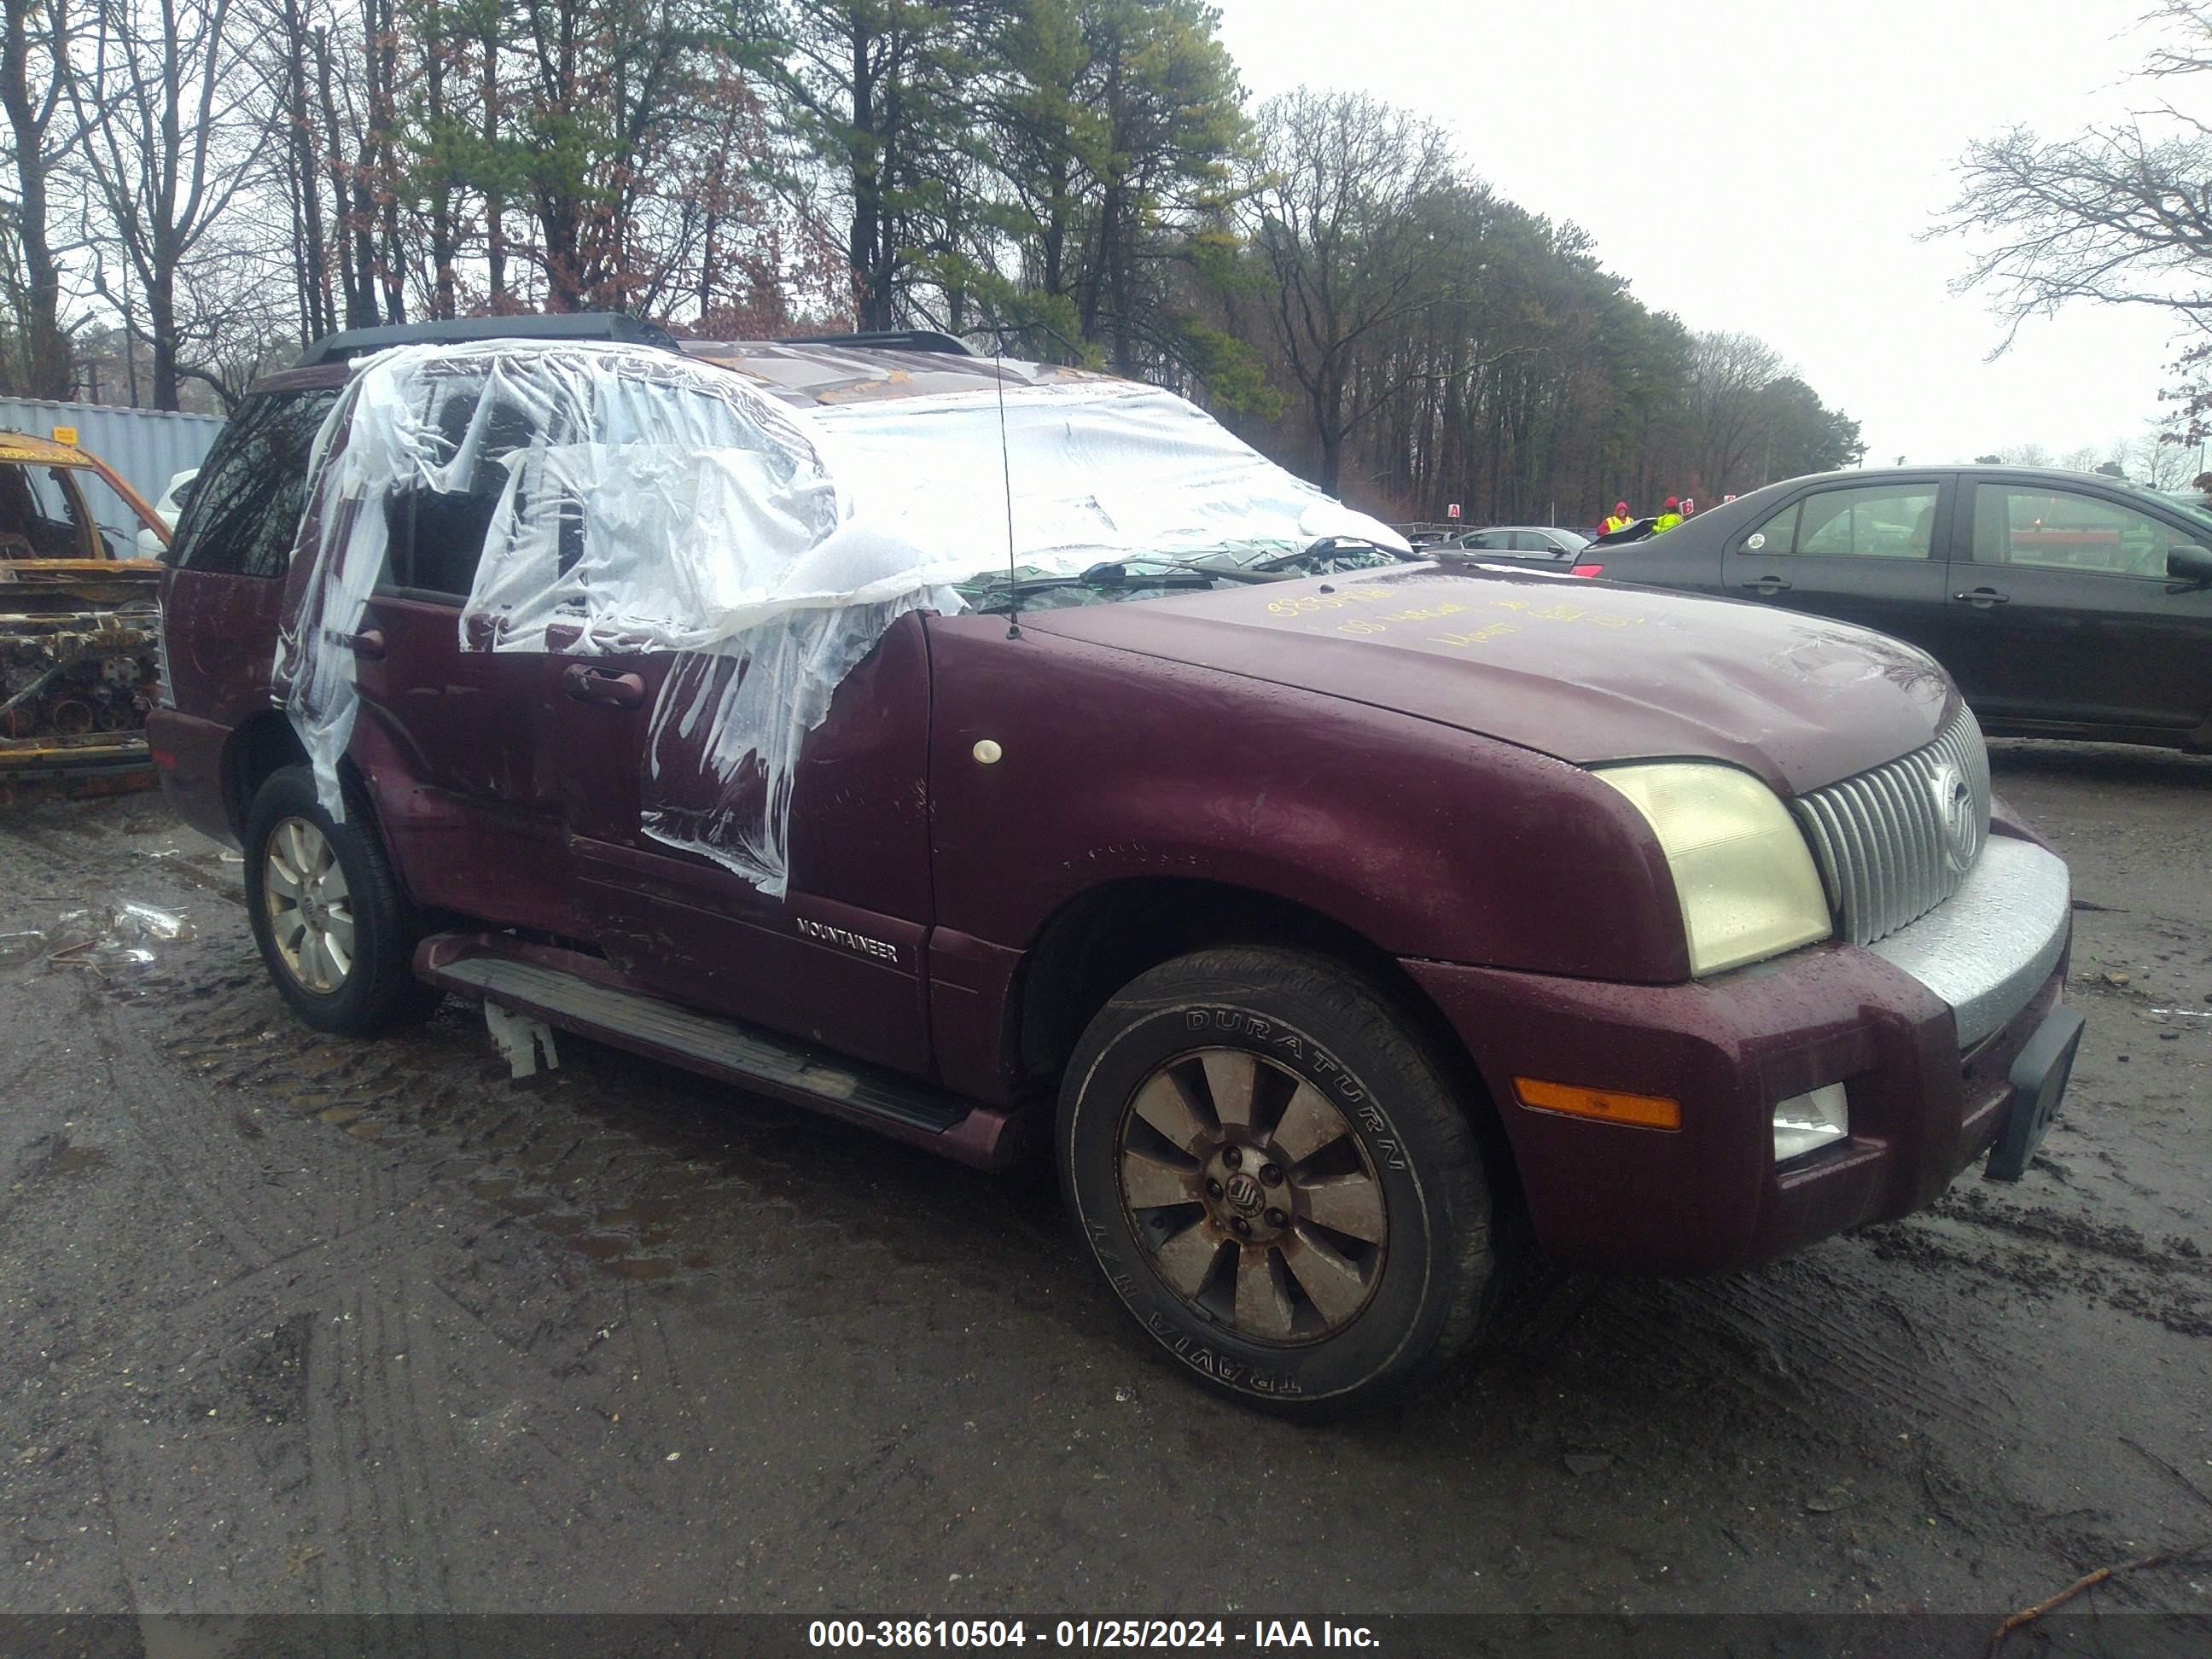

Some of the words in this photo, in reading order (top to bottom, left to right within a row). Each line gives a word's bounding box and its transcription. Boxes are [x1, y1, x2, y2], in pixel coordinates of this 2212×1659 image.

[796, 917, 899, 963] MOUNTAINEER
[1185, 1010, 1406, 1170] DURATURN
[1148, 1311, 1302, 1394] TRAVIA
